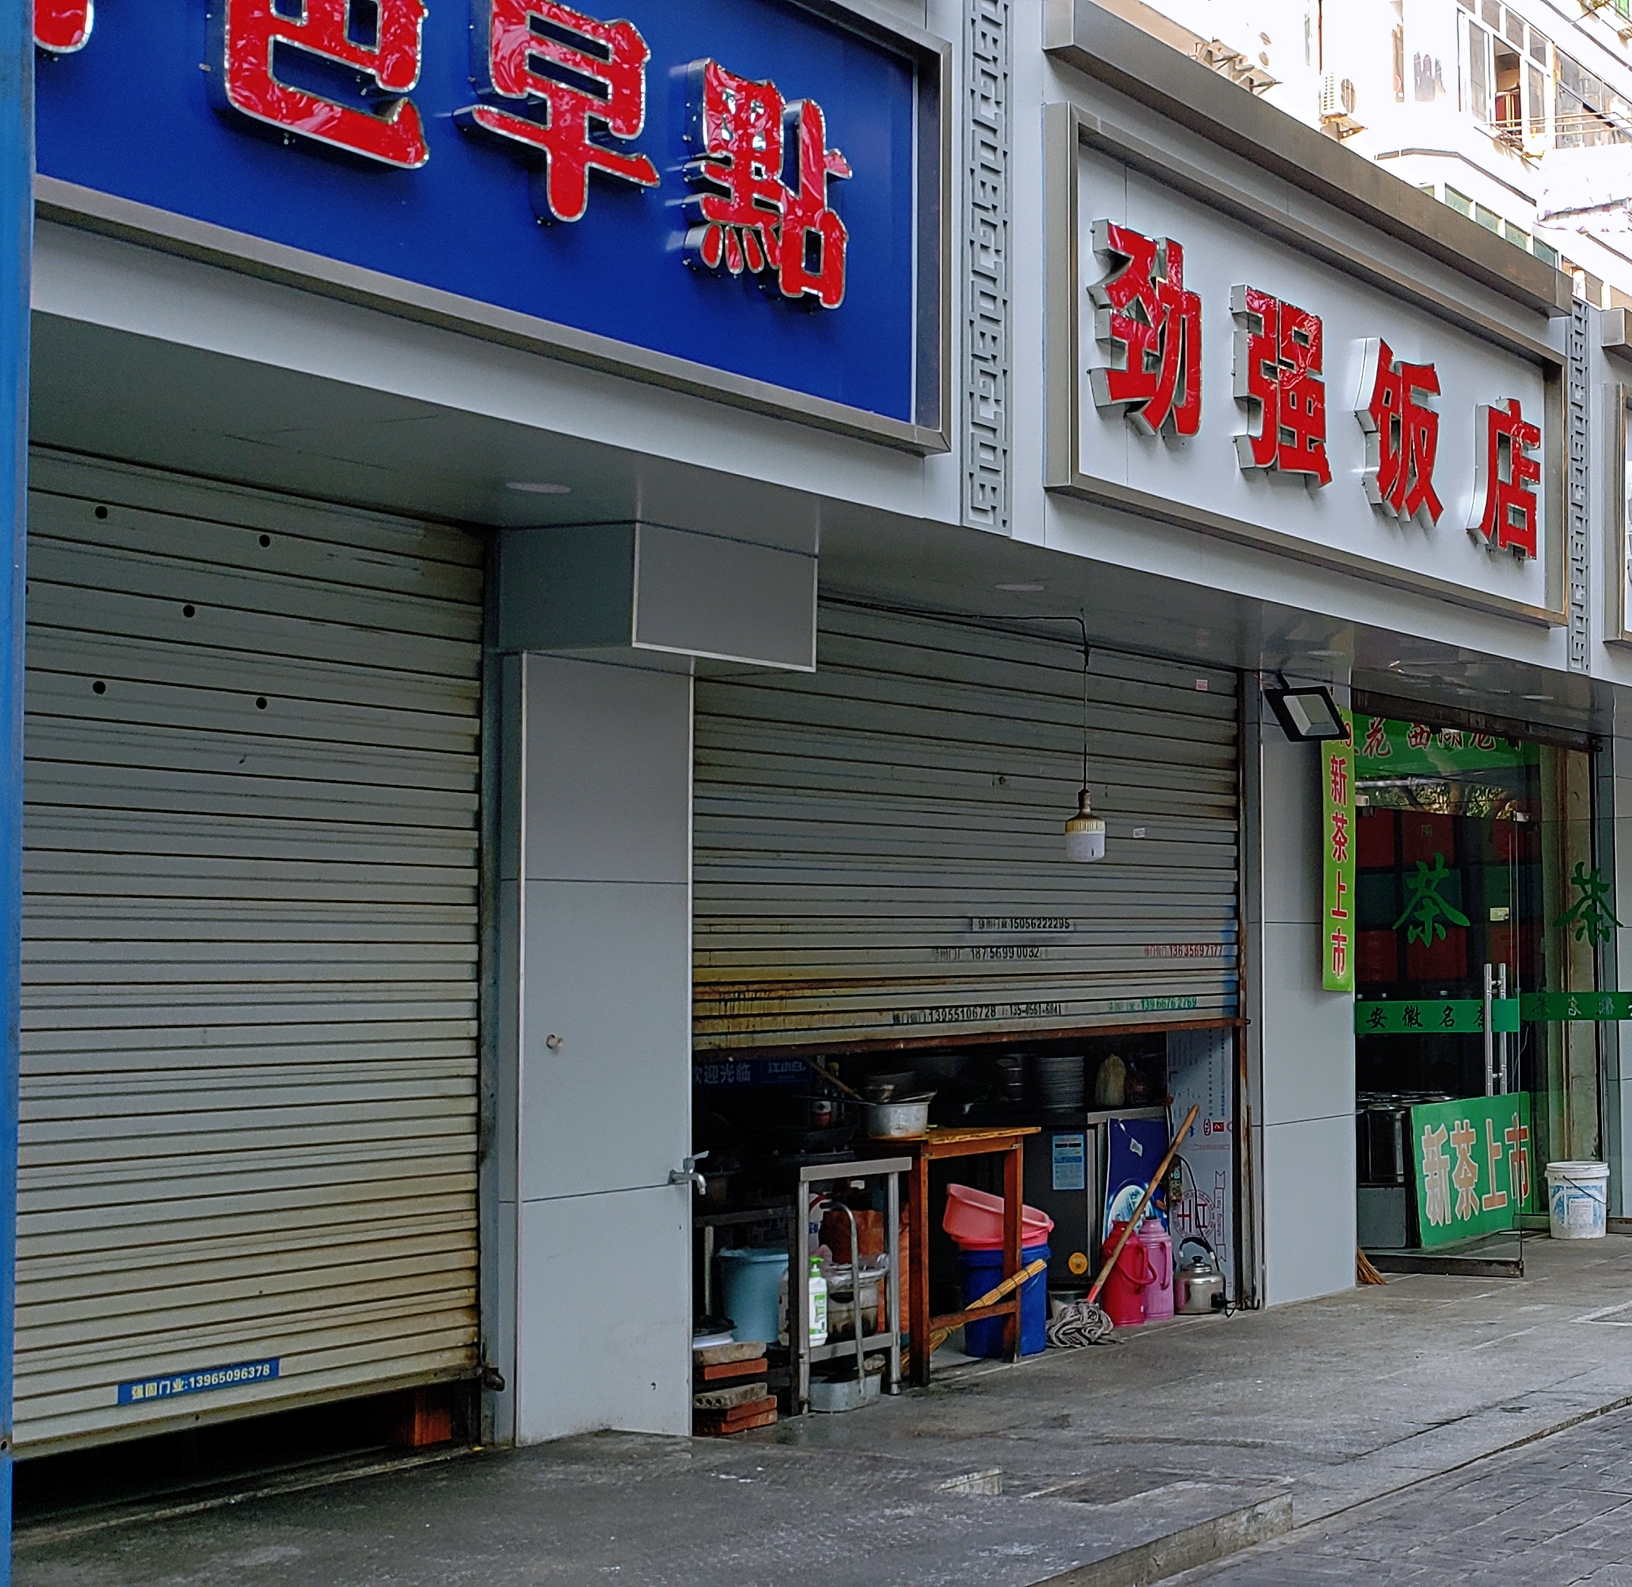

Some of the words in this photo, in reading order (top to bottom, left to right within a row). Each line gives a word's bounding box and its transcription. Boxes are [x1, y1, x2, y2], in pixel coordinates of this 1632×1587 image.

[35, 0, 853, 310] 色早點
[1090, 219, 1542, 562] 劲强饭店
[1407, 721, 1522, 751] 西湖龙
[1329, 753, 1349, 979] 新茶上市
[1392, 852, 1471, 948] 茶
[1421, 1112, 1530, 1227] 新茶上市
